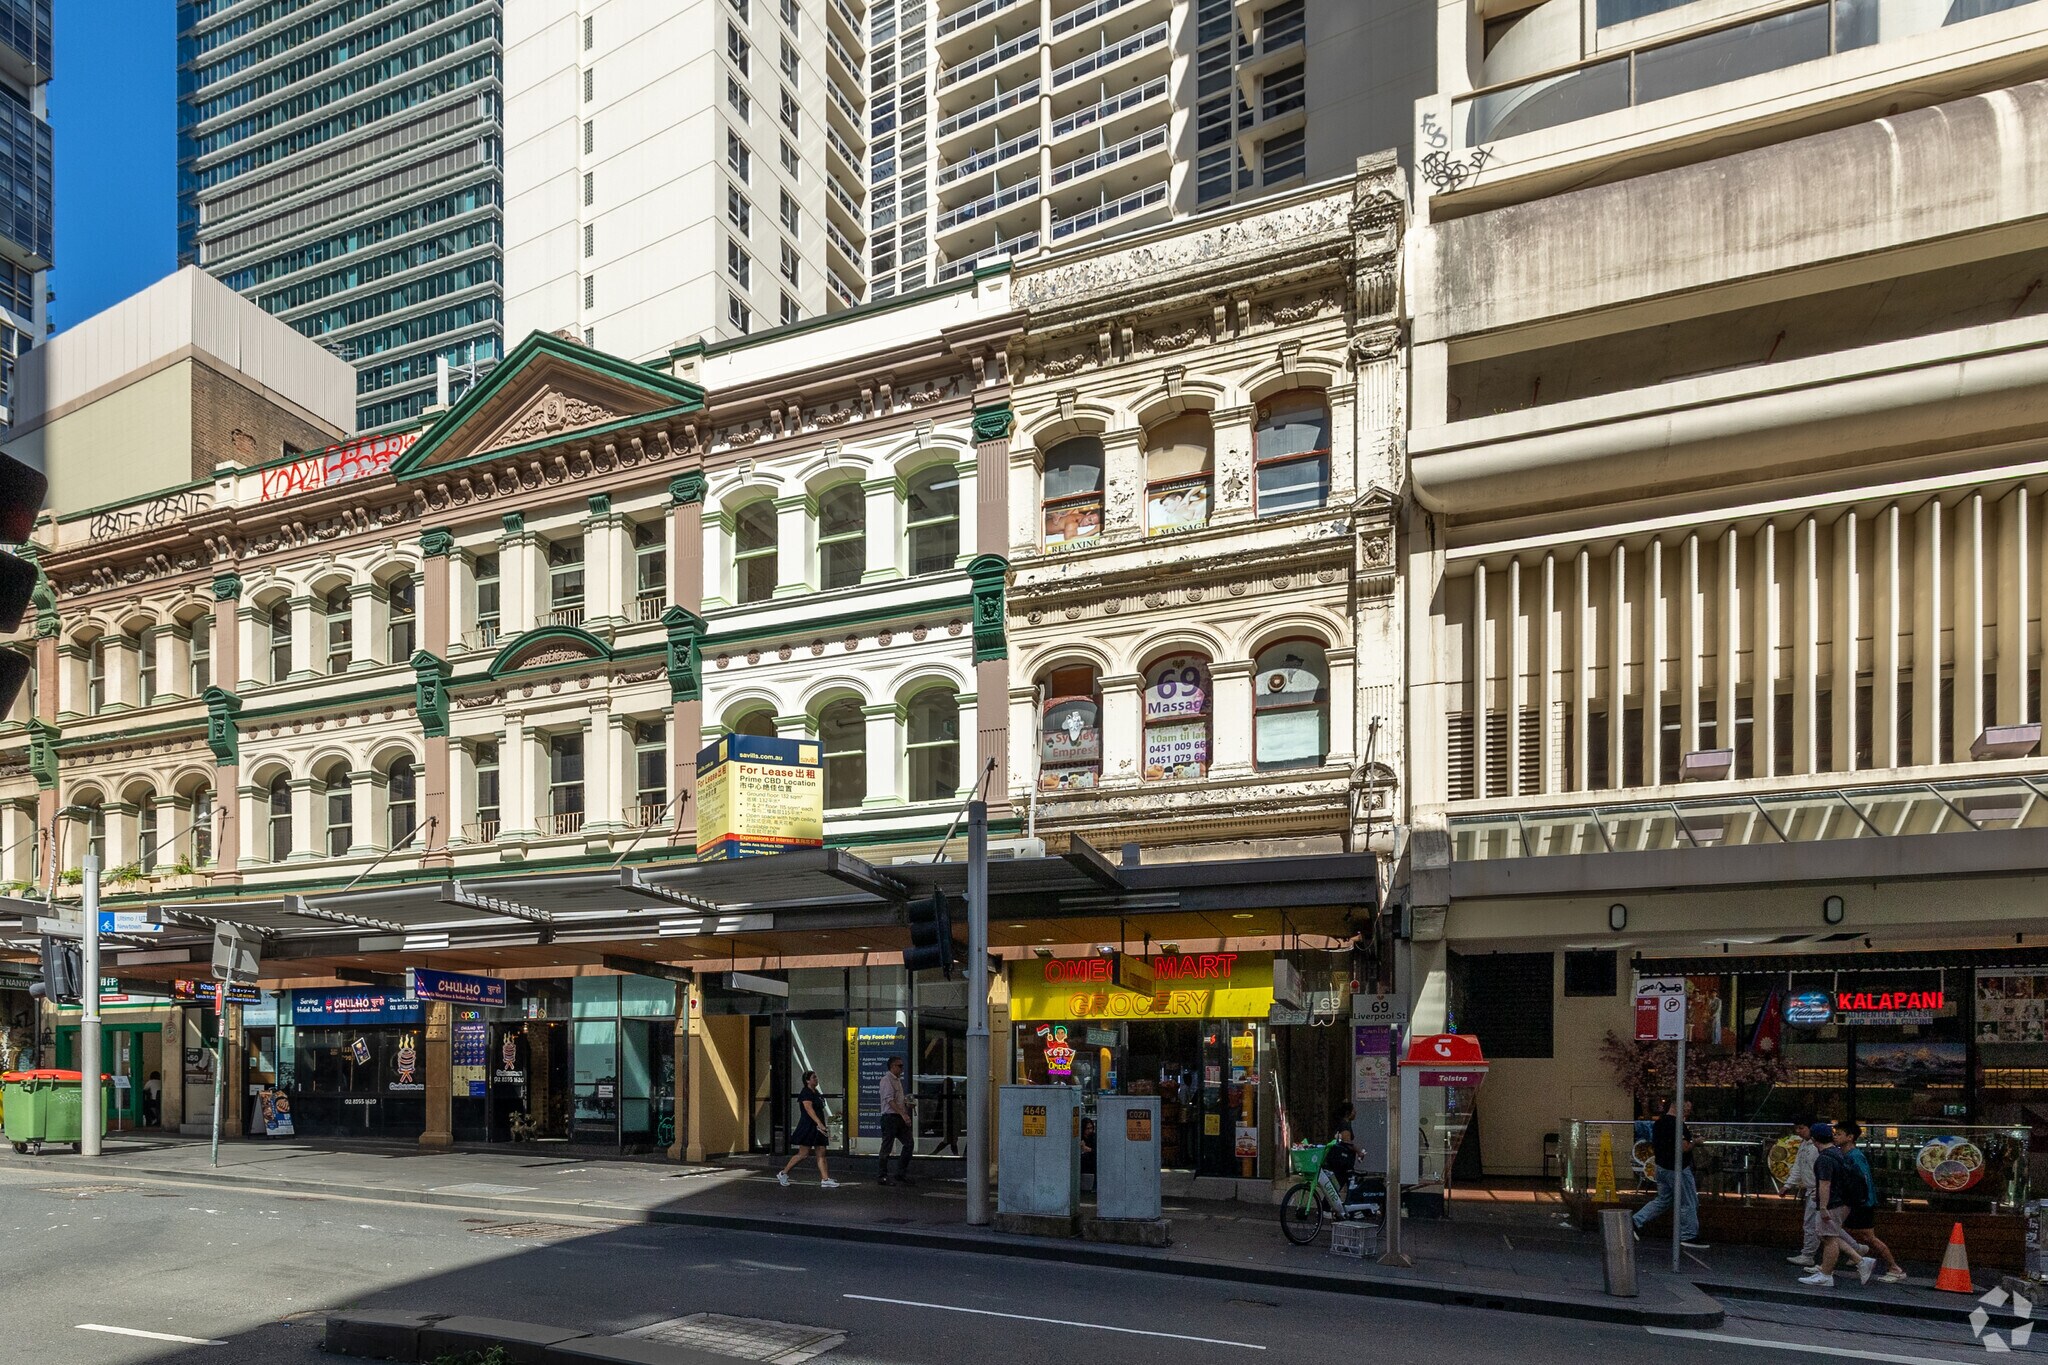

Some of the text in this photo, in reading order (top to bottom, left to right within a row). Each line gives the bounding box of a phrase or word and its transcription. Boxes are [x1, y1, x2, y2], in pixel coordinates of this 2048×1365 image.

[1157, 666, 1200, 700] 69
[1148, 699, 1210, 716] Massage
[1151, 731, 1207, 744] 10am til lat
[1149, 740, 1206, 754] 0451 009 66
[739, 752, 783, 761] savills.com.au
[1149, 752, 1206, 765] 0451 079 66
[740, 765, 815, 779] For Lease 出租
[740, 775, 762, 783] Prime
[784, 779, 816, 787] Location
[1154, 953, 1238, 980] MART
[6, 978, 33, 987] NANYA
[438, 980, 481, 995] CHULHO
[300, 997, 319, 1005] Serving
[334, 998, 369, 1009] CHULHO
[1069, 990, 1210, 1017] GROCERY
[1321, 998, 1341, 1009] 69
[1838, 991, 1943, 1010] KALAPANI
[1371, 1001, 1389, 1013] 69
[461, 1011, 480, 1020] open
[1277, 1013, 1307, 1021] OPEN
[1354, 1012, 1406, 1021] Liverpool St
[1846, 1011, 1890, 1019] AUTHENTIC
[1048, 1061, 1071, 1070] OMEGA
[1024, 1106, 1046, 1115] 4646
[1325, 1180, 1339, 1202] Lime
